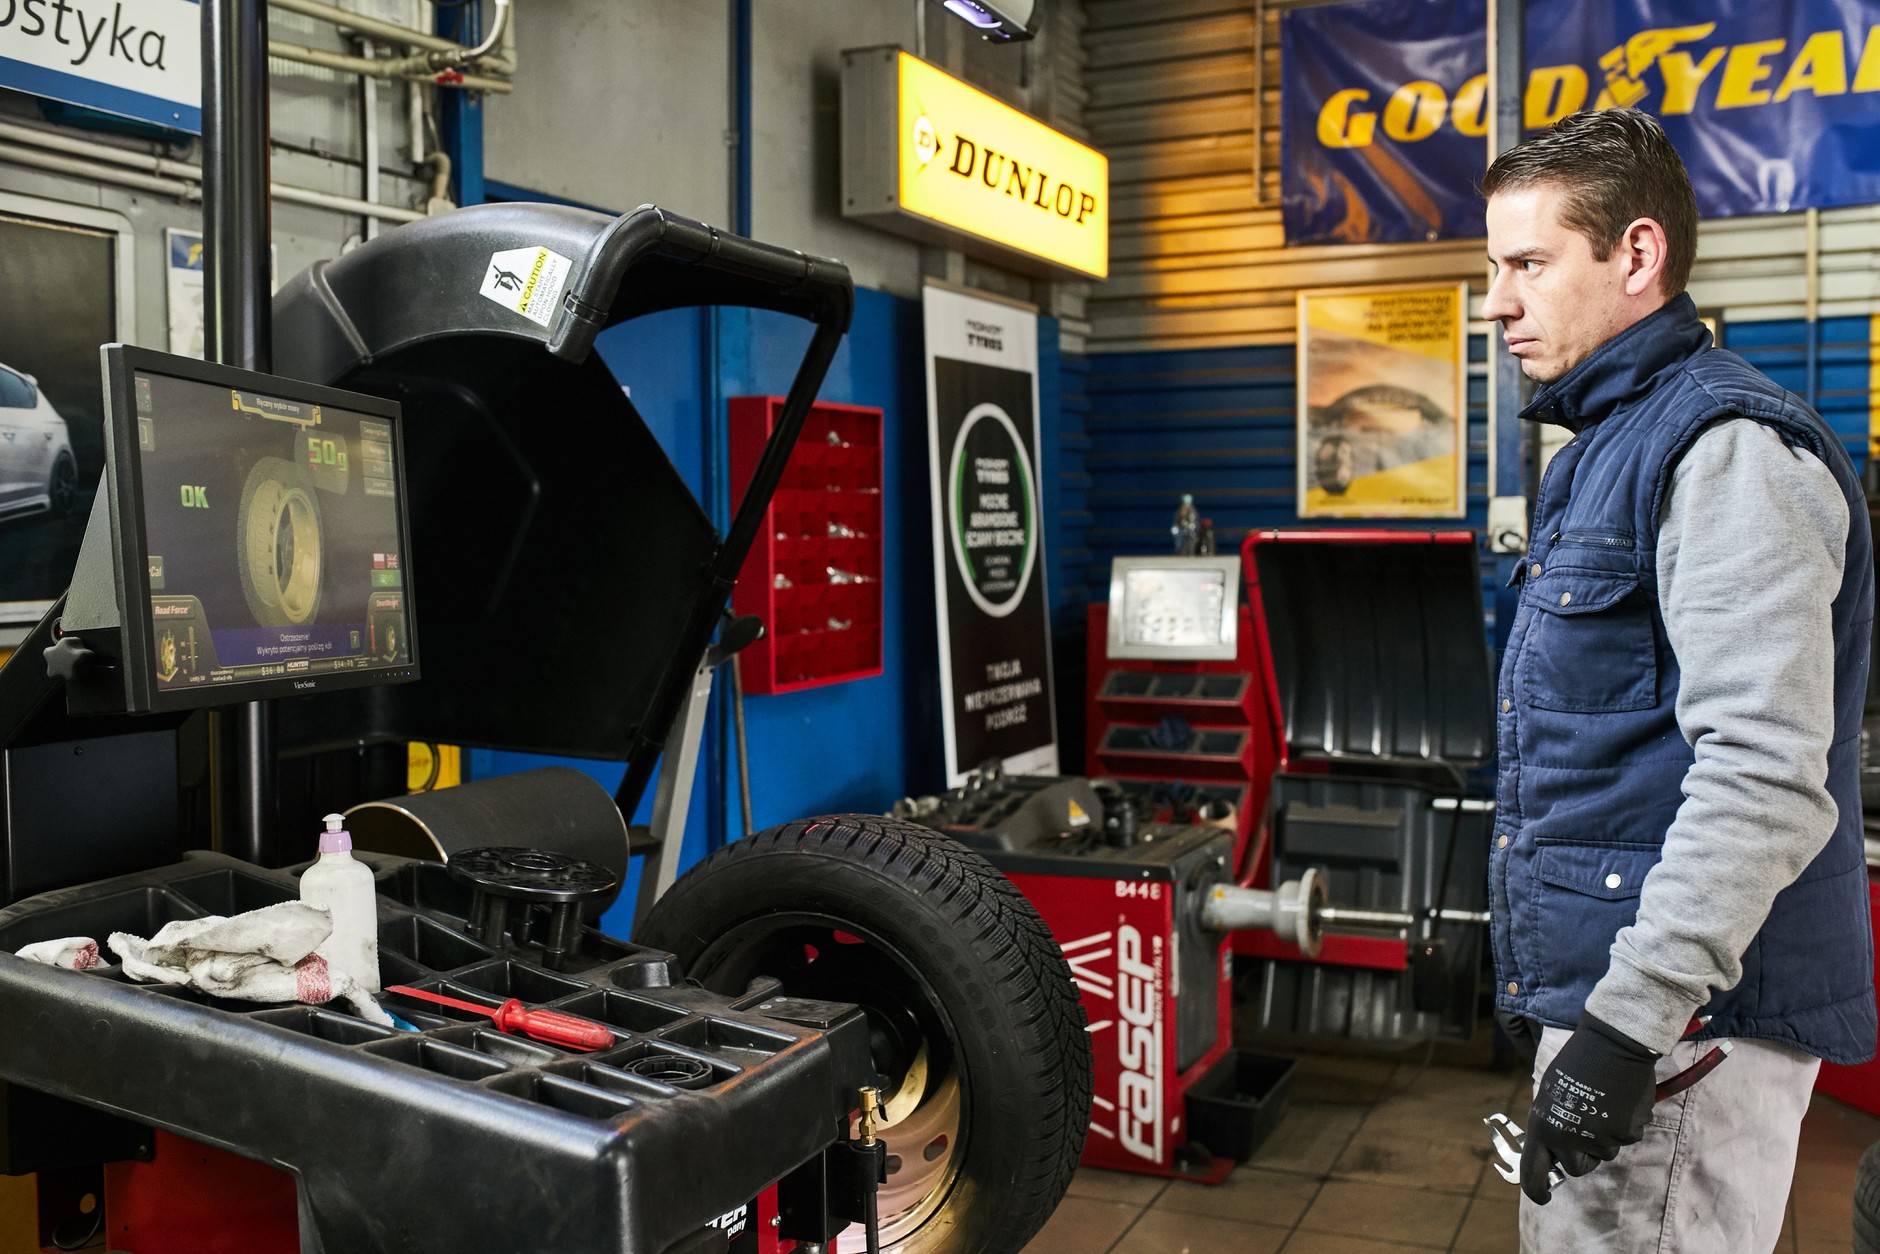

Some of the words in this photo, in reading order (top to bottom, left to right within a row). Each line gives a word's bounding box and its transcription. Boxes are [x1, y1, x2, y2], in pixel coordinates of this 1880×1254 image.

[950, 135, 1095, 223] DUNLOP
[523, 252, 546, 300] CAUTION
[532, 259, 557, 315] AUTOMATICALLY
[537, 300, 548, 319] UPON
[546, 276, 557, 299] HOOD
[543, 290, 558, 321] CLOSING
[181, 485, 210, 508] OK
[294, 680, 316, 689] ViewSonic
[1557, 1078, 1569, 1088] PU
[1568, 1084, 1596, 1102] BLACK
